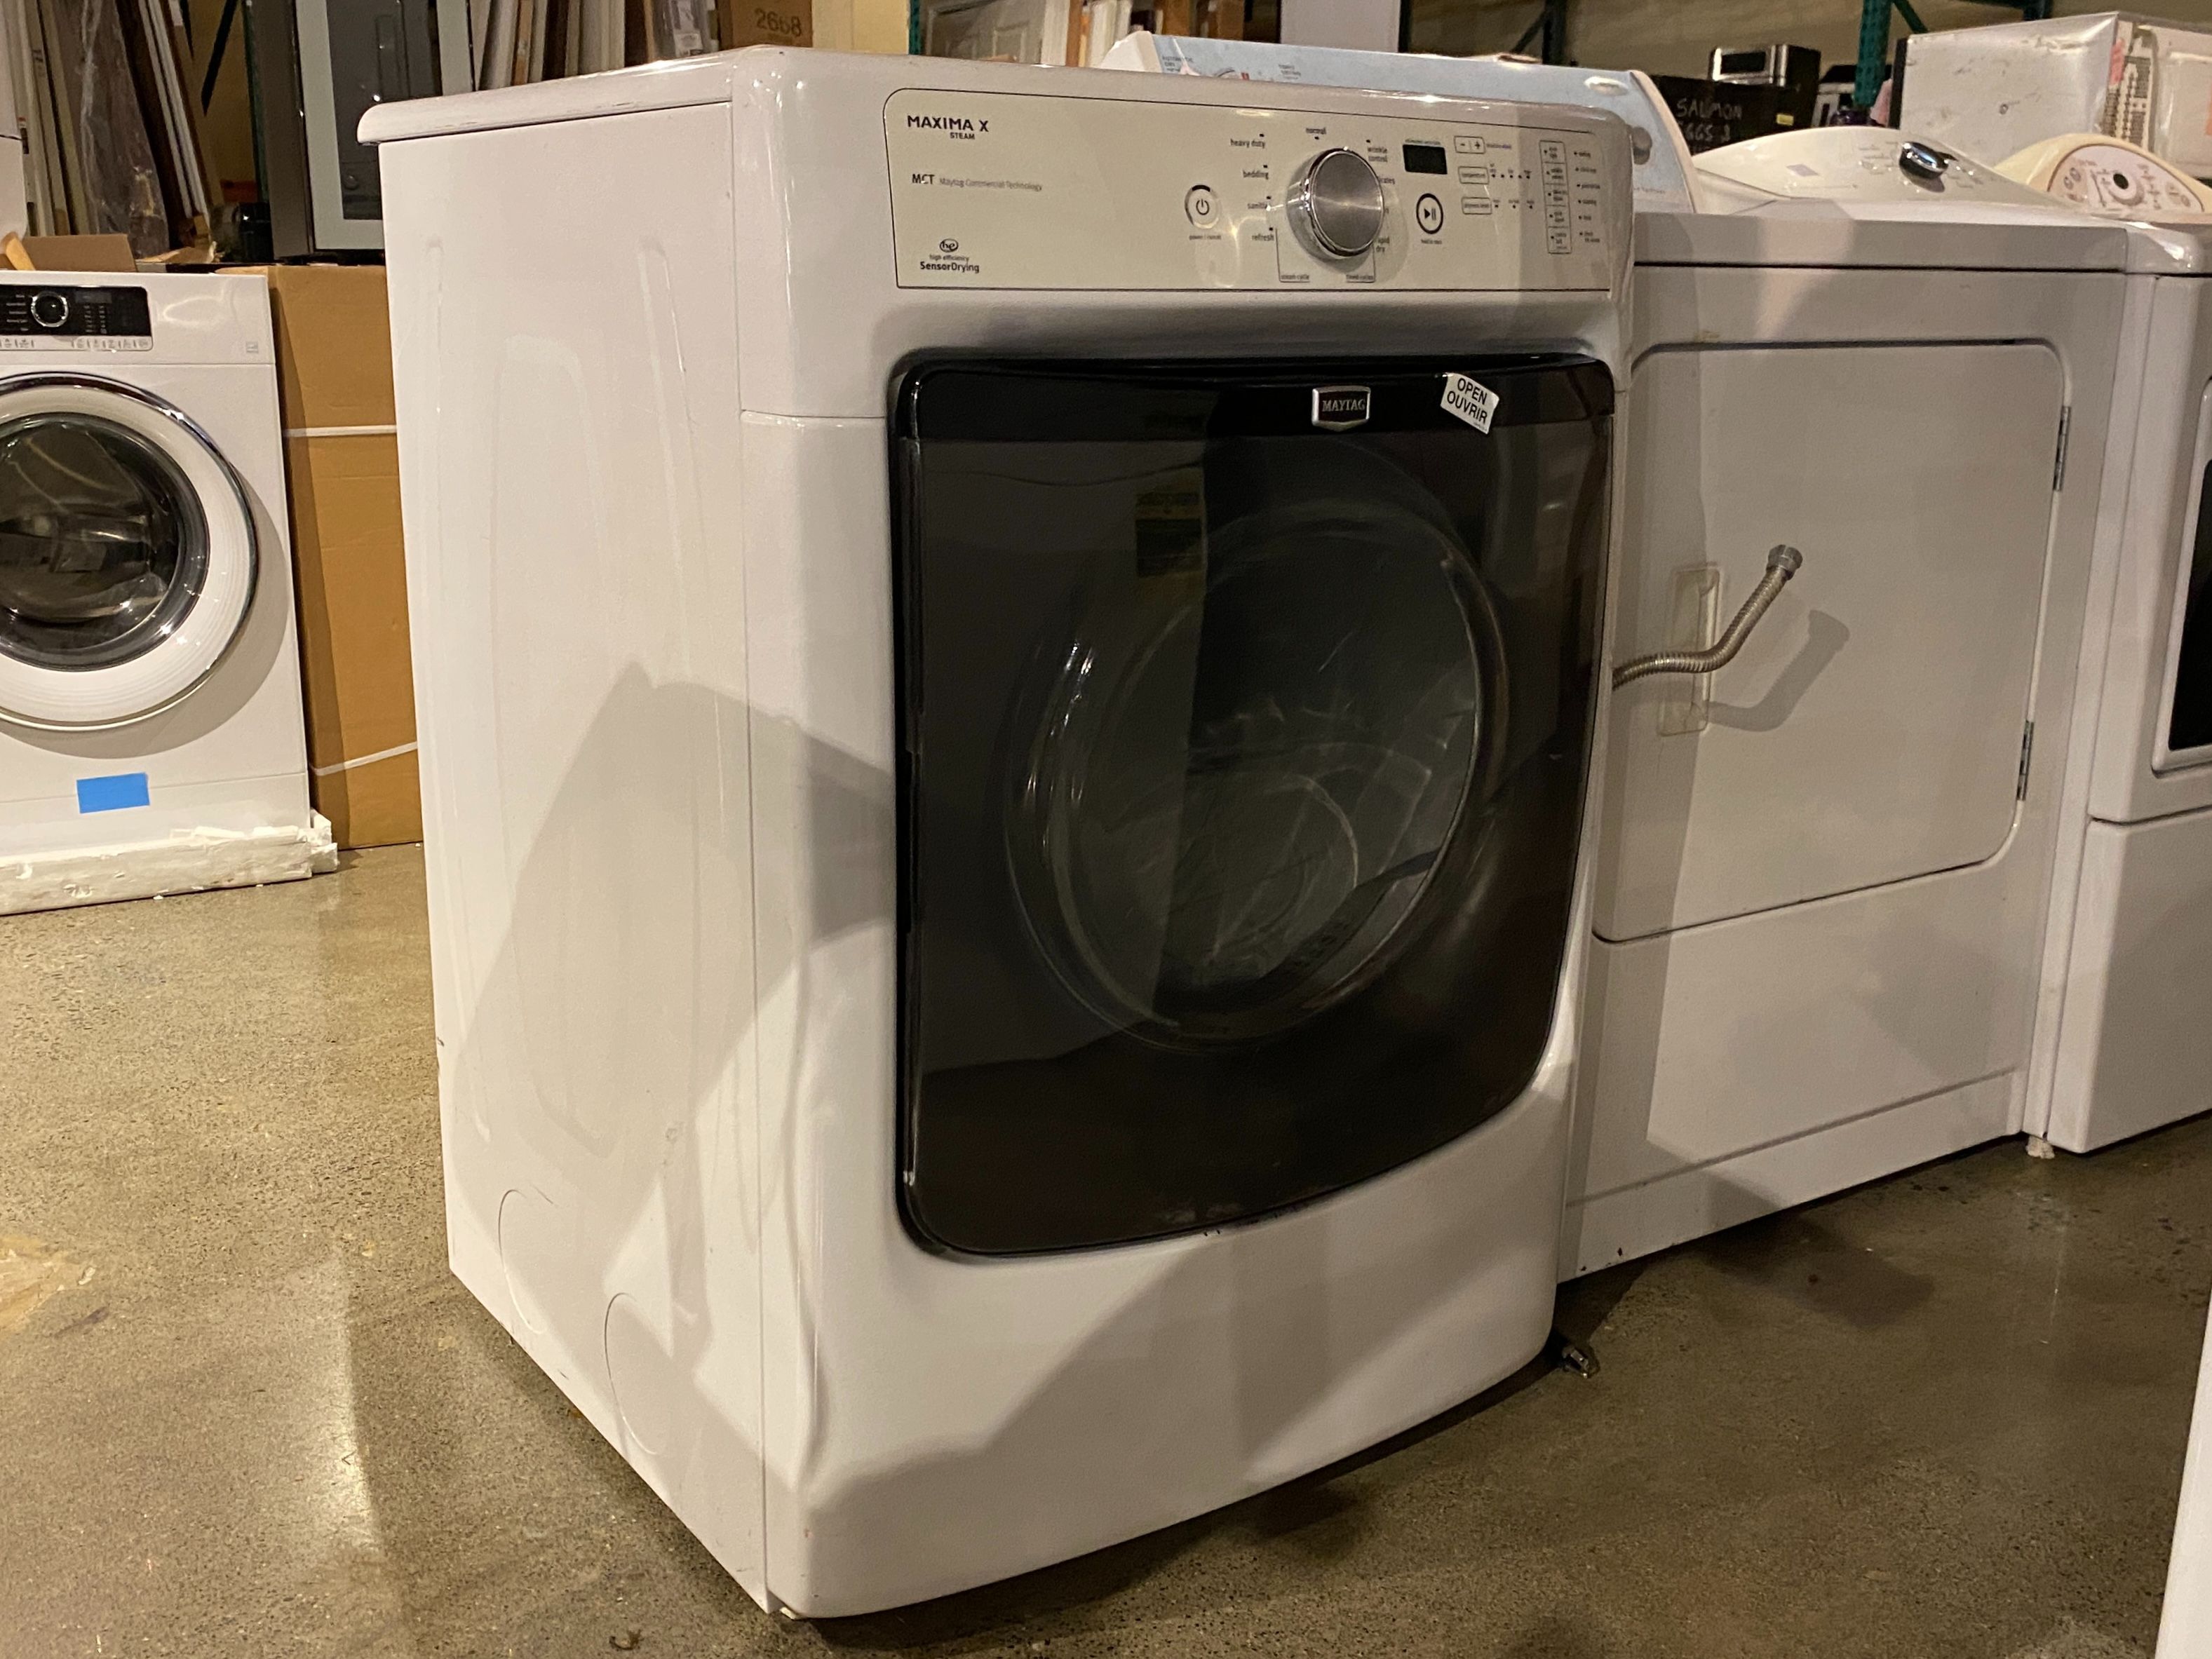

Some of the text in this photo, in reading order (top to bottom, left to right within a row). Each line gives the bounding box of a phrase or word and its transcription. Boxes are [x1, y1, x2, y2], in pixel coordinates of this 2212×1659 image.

[754, 8, 802, 37] 2668
[1676, 97, 1742, 121] SALMON
[907, 114, 990, 133] MAXIMA X
[950, 132, 976, 140] STEAM
[1305, 127, 1328, 135] normal
[1229, 138, 1266, 149] heavy duty
[1242, 169, 1269, 181] bedding
[1251, 232, 1274, 242] refresh
[919, 260, 980, 274] SensorDrying
[1457, 377, 1488, 406] OPEN
[1321, 398, 1366, 412] MAYTAG
[1446, 391, 1488, 424] OUVRIR
